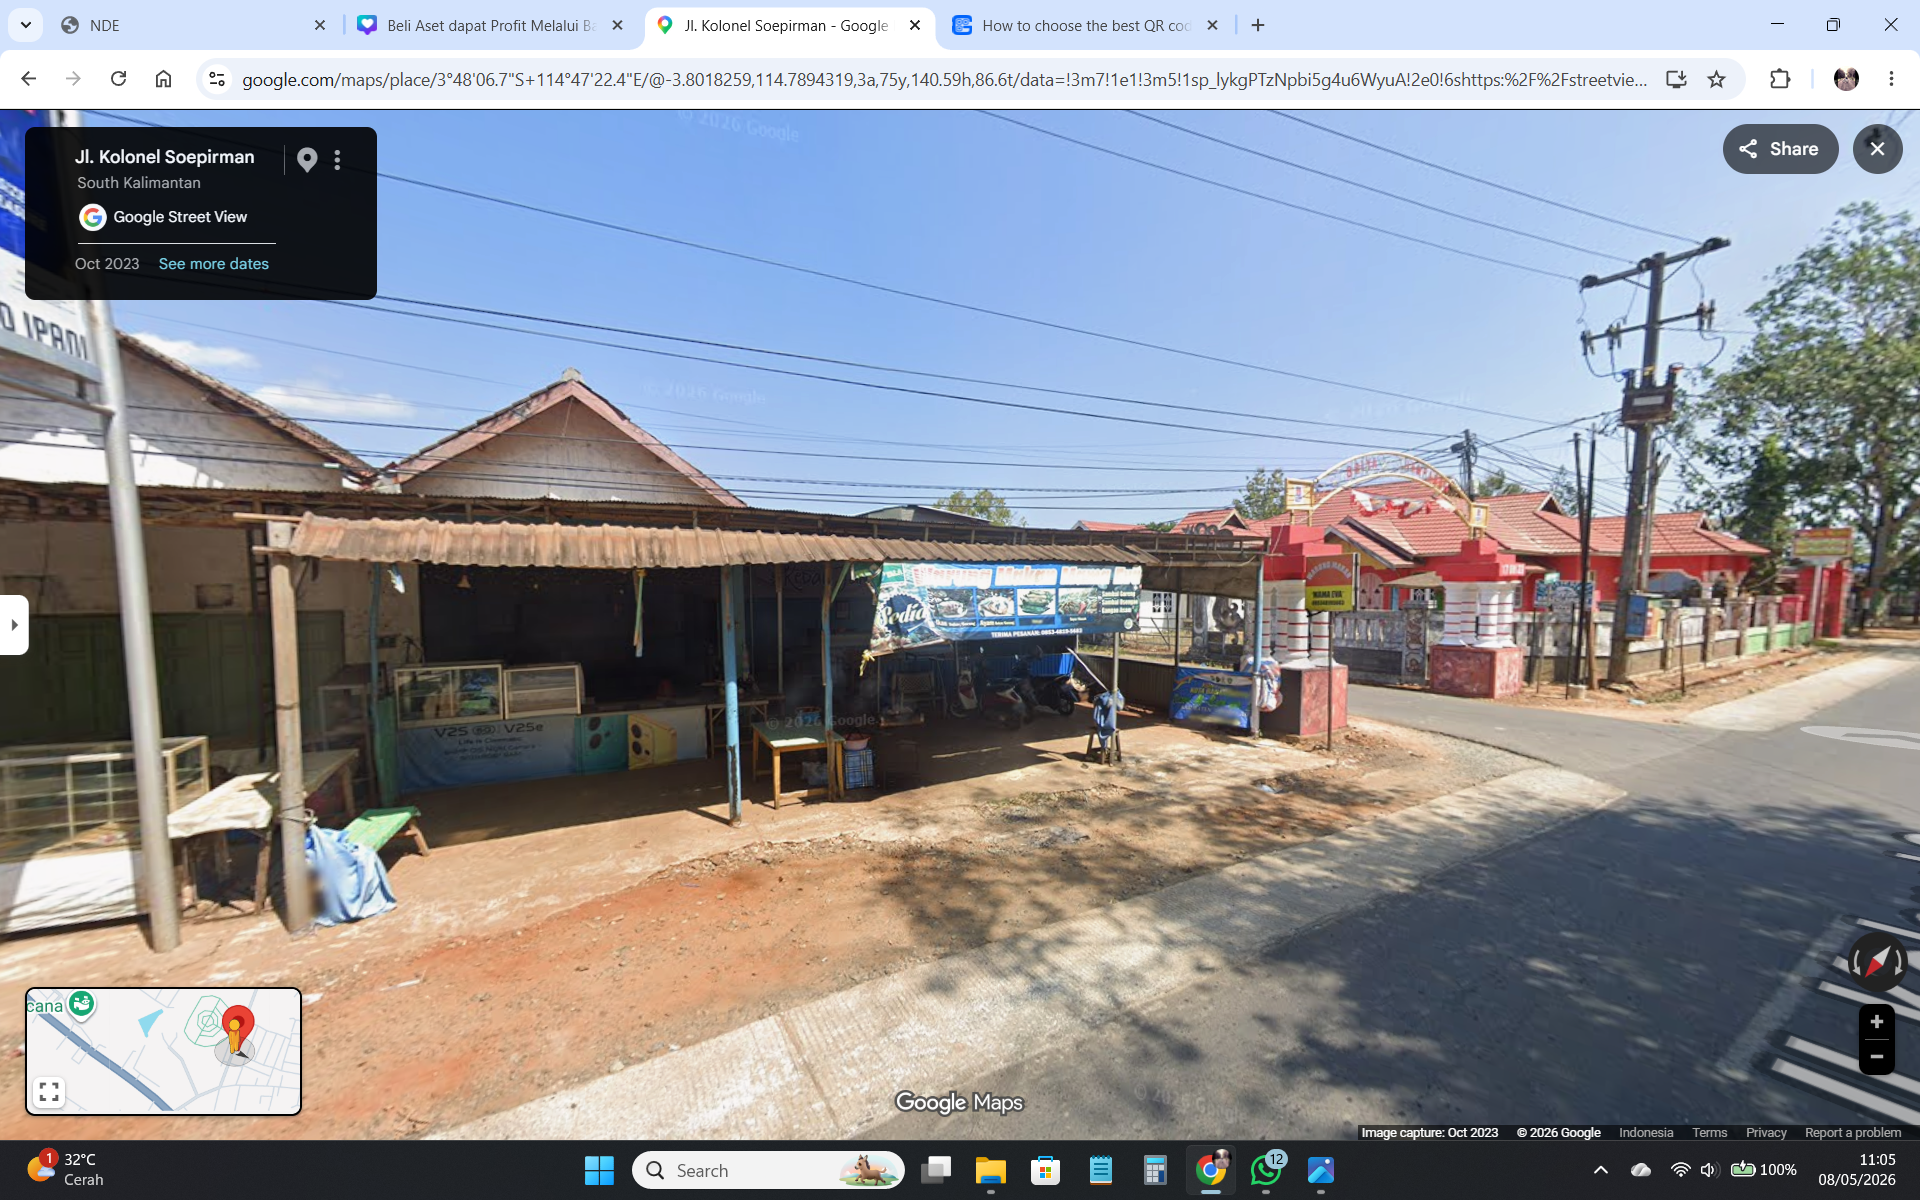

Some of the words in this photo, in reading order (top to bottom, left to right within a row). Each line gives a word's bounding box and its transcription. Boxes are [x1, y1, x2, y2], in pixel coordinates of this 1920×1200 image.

[90, 19, 120, 32] NDE
[388, 19, 411, 32] Beli
[415, 19, 445, 32] Aset
[448, 19, 487, 35] dapat
[491, 19, 527, 32] Profit
[531, 19, 579, 32] Melalui
[684, 19, 698, 32] Jl.
[701, 19, 751, 32] Kolonel
[755, 19, 827, 35] Soepirman
[840, 19, 889, 35] Google
[983, 19, 1014, 32] How
[1016, 20, 1031, 32] to
[1034, 19, 1083, 32] choose
[1085, 19, 1108, 32] the
[1112, 19, 1141, 32] best
[1143, 19, 1165, 33] QR
[880, 603, 927, 626] Sedia
[504, 722, 545, 734] V25e
[27, 1002, 63, 1013] cana
[64, 1153, 96, 1166] 32°C
[1270, 1153, 1284, 1165] 12
[1860, 1153, 1897, 1166] 11:05
[677, 1163, 729, 1178] Search
[1760, 1163, 1798, 1176] 100%
[64, 1173, 104, 1186] Cerah
[1818, 1173, 1897, 1187] 08/05/2026
